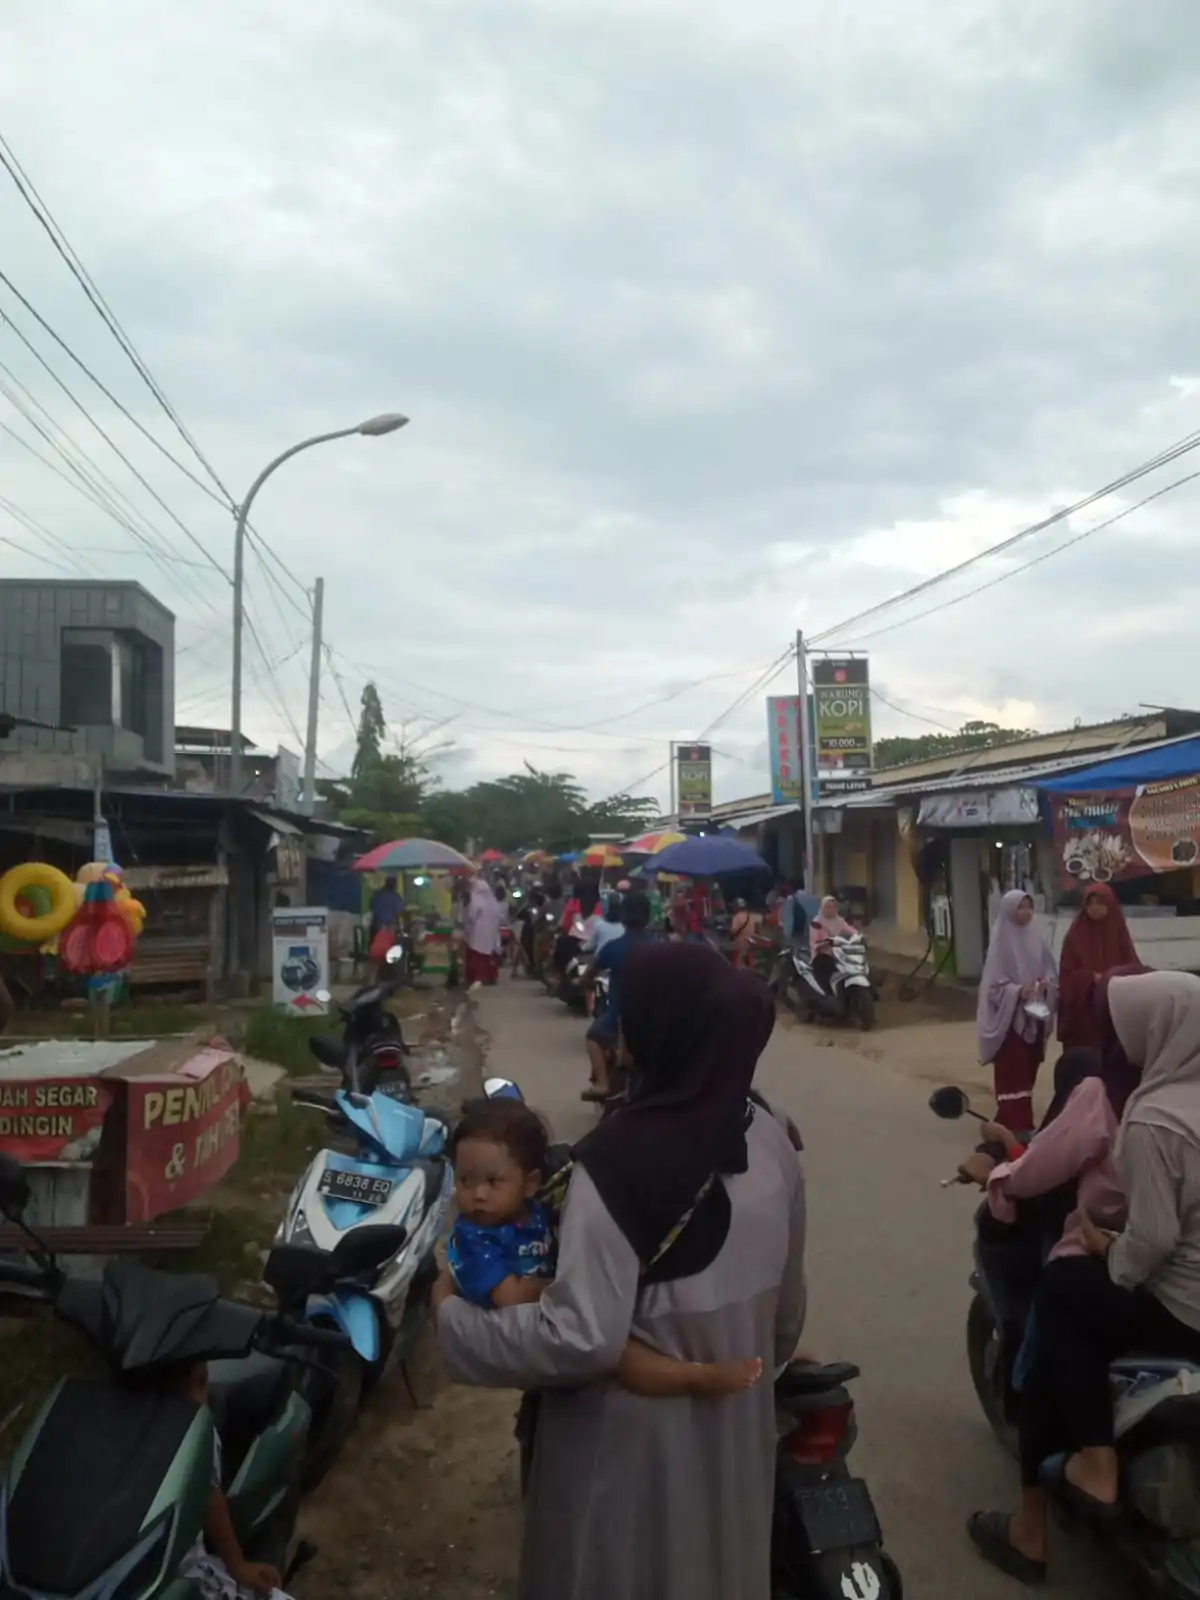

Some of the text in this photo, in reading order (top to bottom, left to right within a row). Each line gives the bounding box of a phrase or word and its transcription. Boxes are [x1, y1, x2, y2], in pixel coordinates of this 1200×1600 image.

[820, 688, 863, 699] WARUNG
[819, 699, 863, 717] KOPI
[35, 1086, 97, 1106] SEGAR
[0, 1116, 72, 1135] DINGIN
[165, 1142, 187, 1180] &
